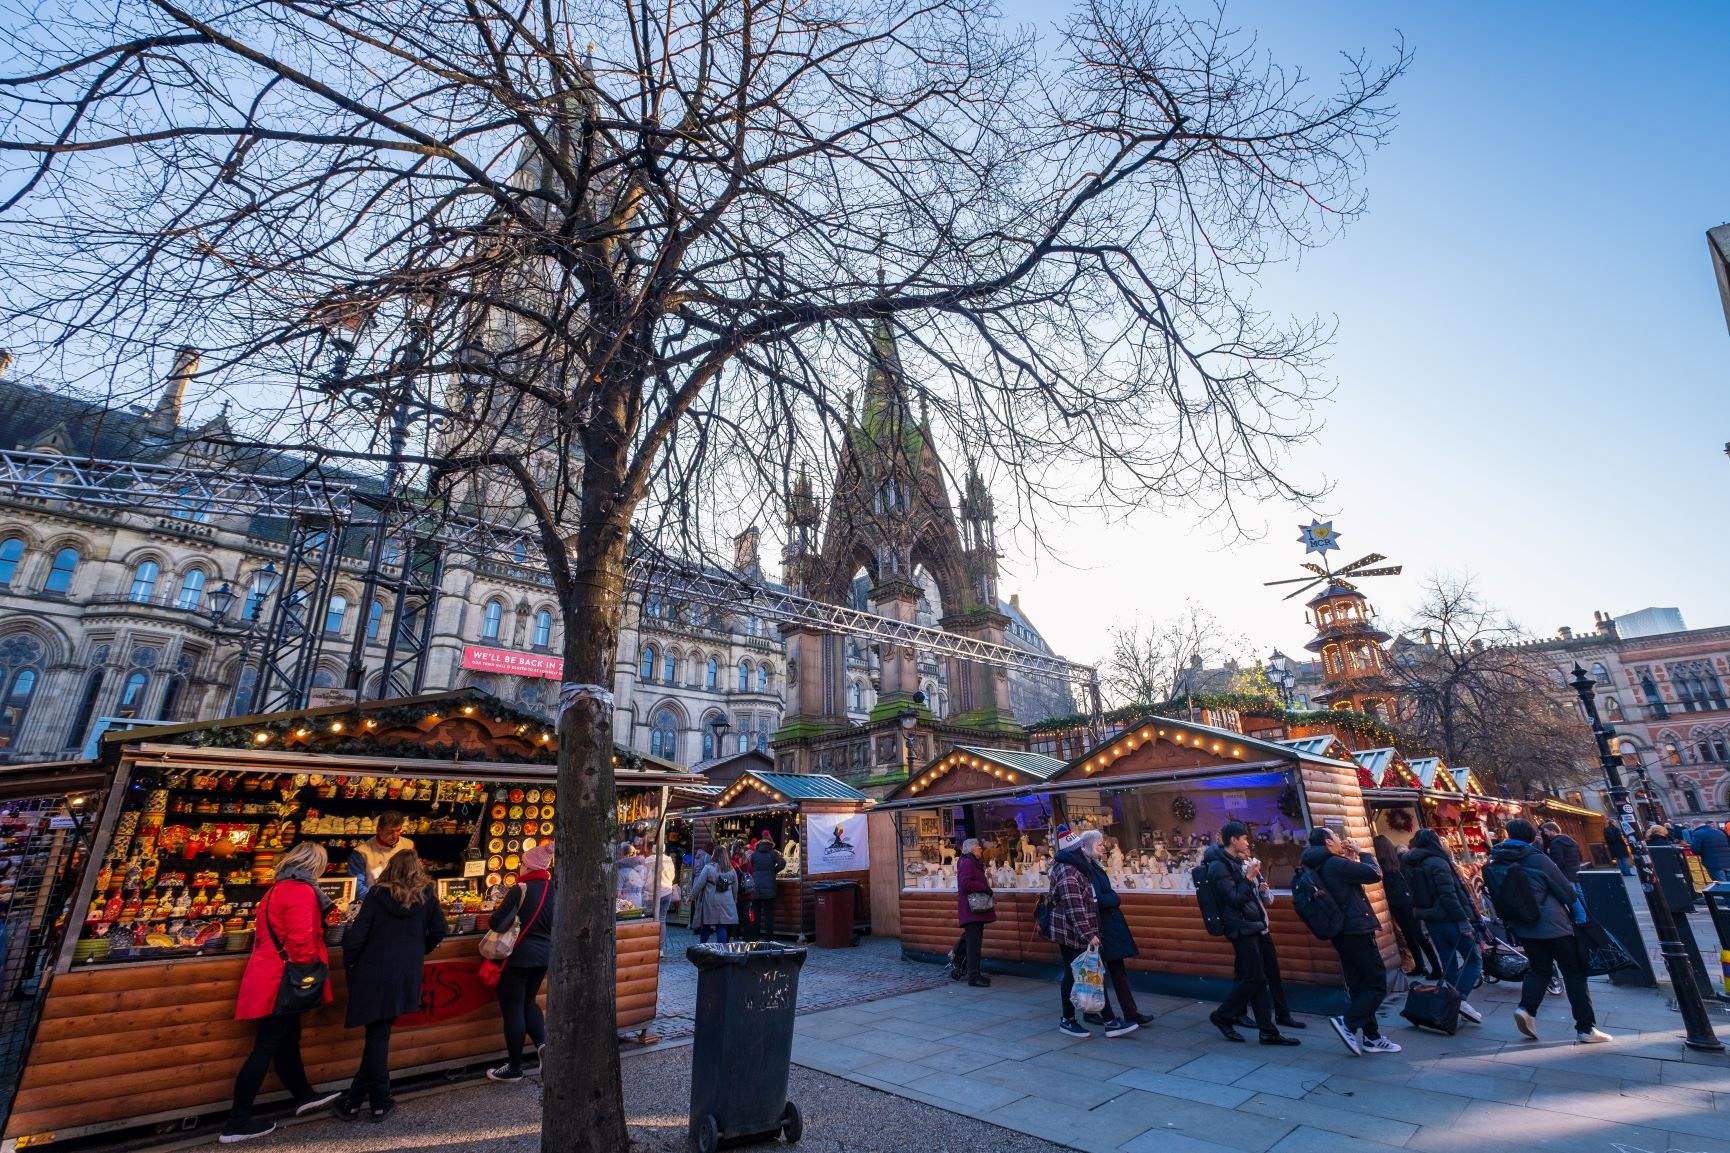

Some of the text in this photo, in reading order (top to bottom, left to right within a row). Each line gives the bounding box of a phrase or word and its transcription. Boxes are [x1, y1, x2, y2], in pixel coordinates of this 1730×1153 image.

[1307, 529, 1314, 540] I
[1310, 539, 1332, 547] MCR
[473, 651, 501, 662] WE'LL
[504, 655, 516, 664] BE
[519, 657, 543, 668] BACK
[546, 661, 556, 669] IN
